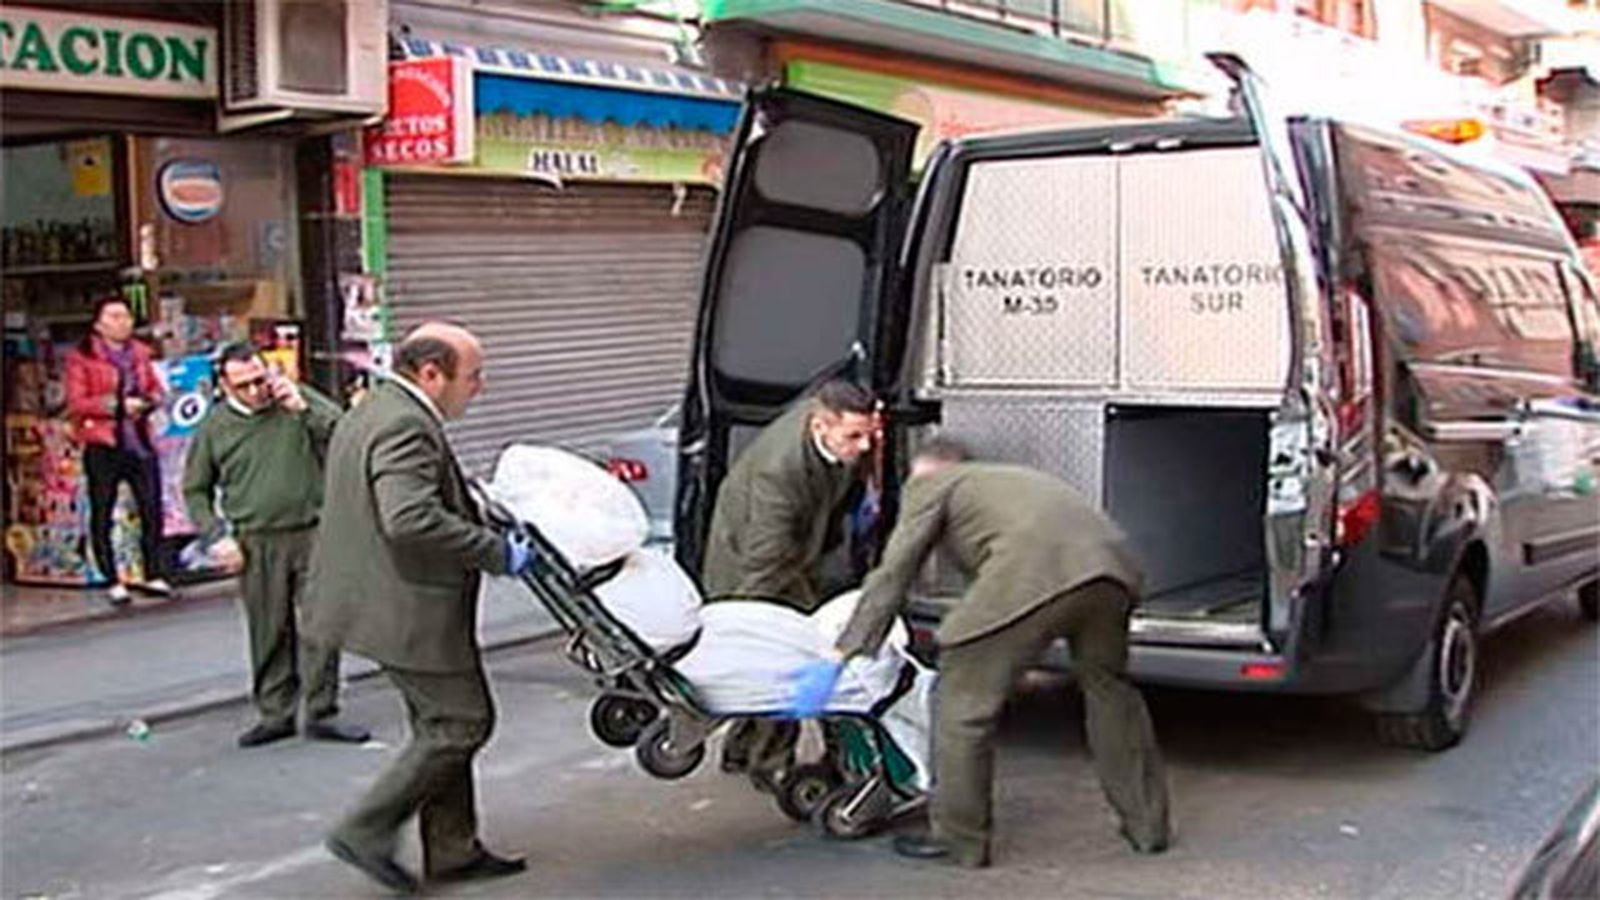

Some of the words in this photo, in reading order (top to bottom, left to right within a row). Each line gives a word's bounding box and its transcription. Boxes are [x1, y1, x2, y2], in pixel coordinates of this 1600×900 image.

[371, 138, 448, 160] SECOS
[965, 267, 1102, 289] TANATORIO
[1190, 290, 1243, 313] SUR
